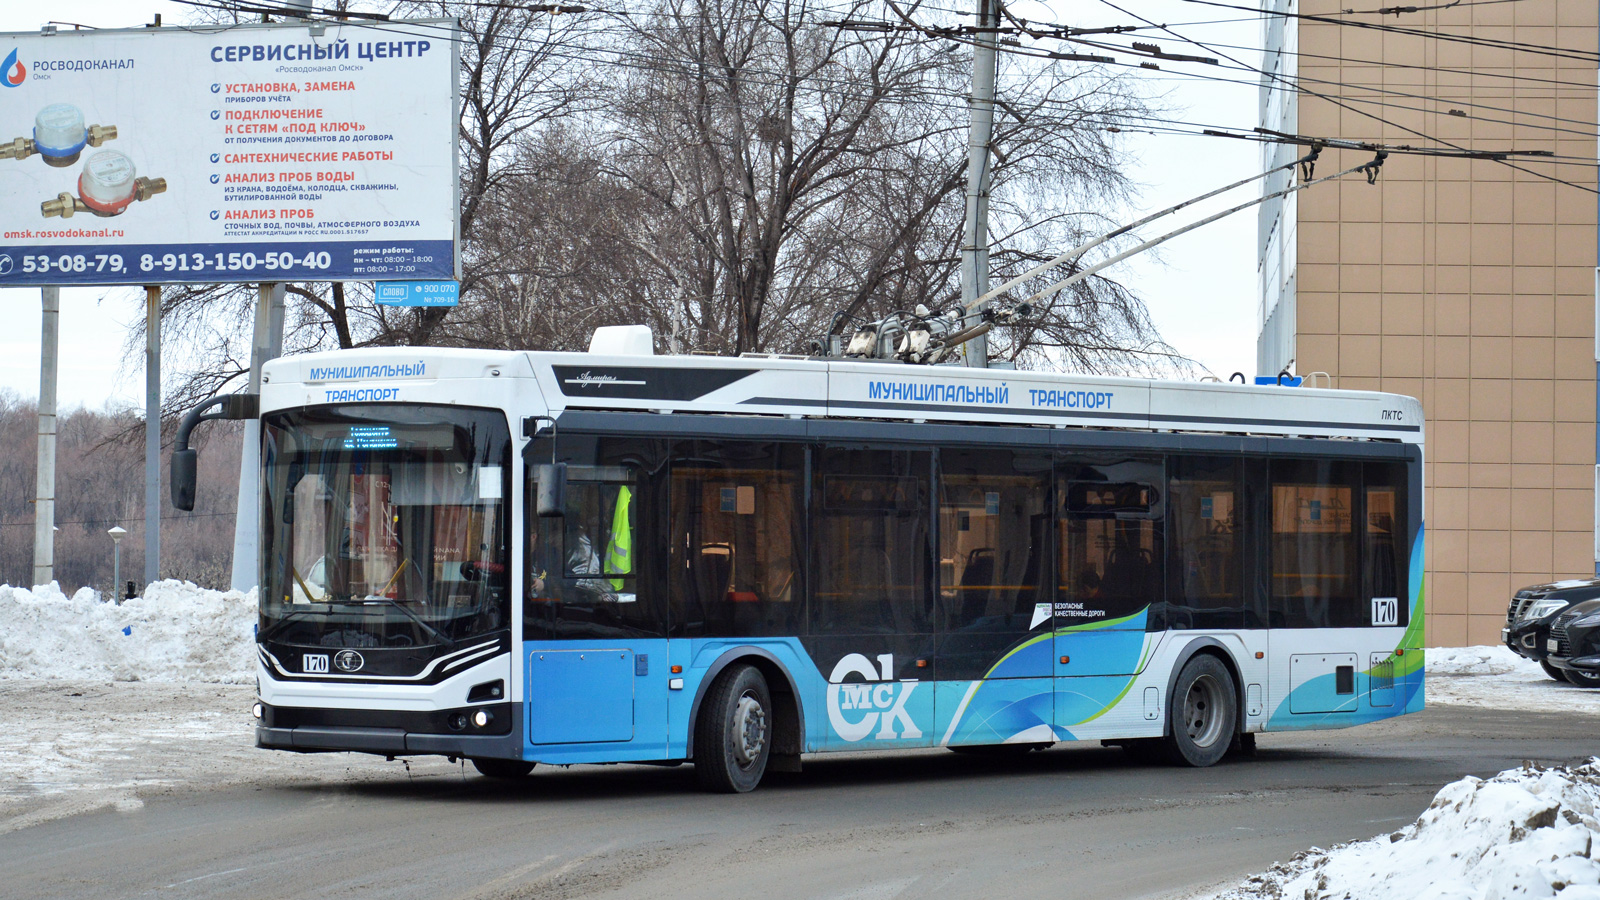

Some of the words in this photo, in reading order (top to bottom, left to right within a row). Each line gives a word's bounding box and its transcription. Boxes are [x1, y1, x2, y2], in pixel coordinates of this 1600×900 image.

[211, 38, 349, 62] СЕРВИСНЫЙ
[358, 41, 430, 61] ЦЕНТР
[33, 59, 134, 72] РОСВОДОКАНАЛ
[275, 65, 336, 73] «Росводоканал
[225, 83, 300, 93] УСТАНОВКА,
[304, 81, 355, 92] ЗАМЕНА
[268, 95, 291, 103] УЧЁТА
[225, 109, 323, 121] ПОДКЛЮЧЕНИЕ
[225, 125, 233, 134] К
[237, 124, 278, 133] СЕТЯМ
[282, 123, 317, 134] «ПОД
[320, 122, 366, 133] КЛЮЧ»
[236, 136, 283, 144] ПОЛУЧЕНИЯ
[284, 135, 338, 144] ДОКУМЕНТОВ
[339, 135, 350, 143] ДО
[352, 134, 393, 142] ДОГОВОРА
[224, 152, 339, 163] САНТЕХНИЧЕСКИЕ
[342, 151, 393, 161] РАБОТЫ
[224, 173, 276, 183] АНАЛИЗ
[279, 172, 313, 182] ПРОБ
[317, 171, 355, 182] ВОДЫ
[266, 184, 306, 193] ВОДОЁМА,
[307, 184, 348, 192] КОЛОДЦА,
[350, 184, 398, 192] СКВАЖИНЫ,
[224, 193, 297, 201] БУТИЛИРОВАННОЙ
[224, 210, 276, 220] АНАЛИЗ
[280, 209, 314, 219] ПРОБ
[263, 222, 282, 230] ВОД,
[284, 221, 315, 229] ПОЧВЫ,
[317, 220, 381, 228] АТМОСФЕРНОГО
[383, 220, 420, 228] ВОЗДУХА
[4, 228, 124, 239] omsk.rosvodokanal.ru
[382, 247, 414, 255] работы:
[23, 254, 127, 274] 53-08-79,
[140, 251, 331, 272] 8-913-150-50-40
[383, 287, 404, 296] СЛОВО
[424, 285, 438, 293] 900
[440, 285, 455, 293] 070
[310, 360, 425, 380] МУНИЦИПАЛЬНЫЙ
[576, 370, 617, 388] Адмирал
[325, 388, 399, 403] ТРАНСПОРТ
[869, 381, 1008, 404] МУНИЦИПАЛЬНЫЙ
[1029, 389, 1113, 410] ТРАНСПОРТ
[1381, 409, 1403, 420] ПКТС
[1374, 601, 1395, 622] 170
[305, 655, 327, 671] 170
